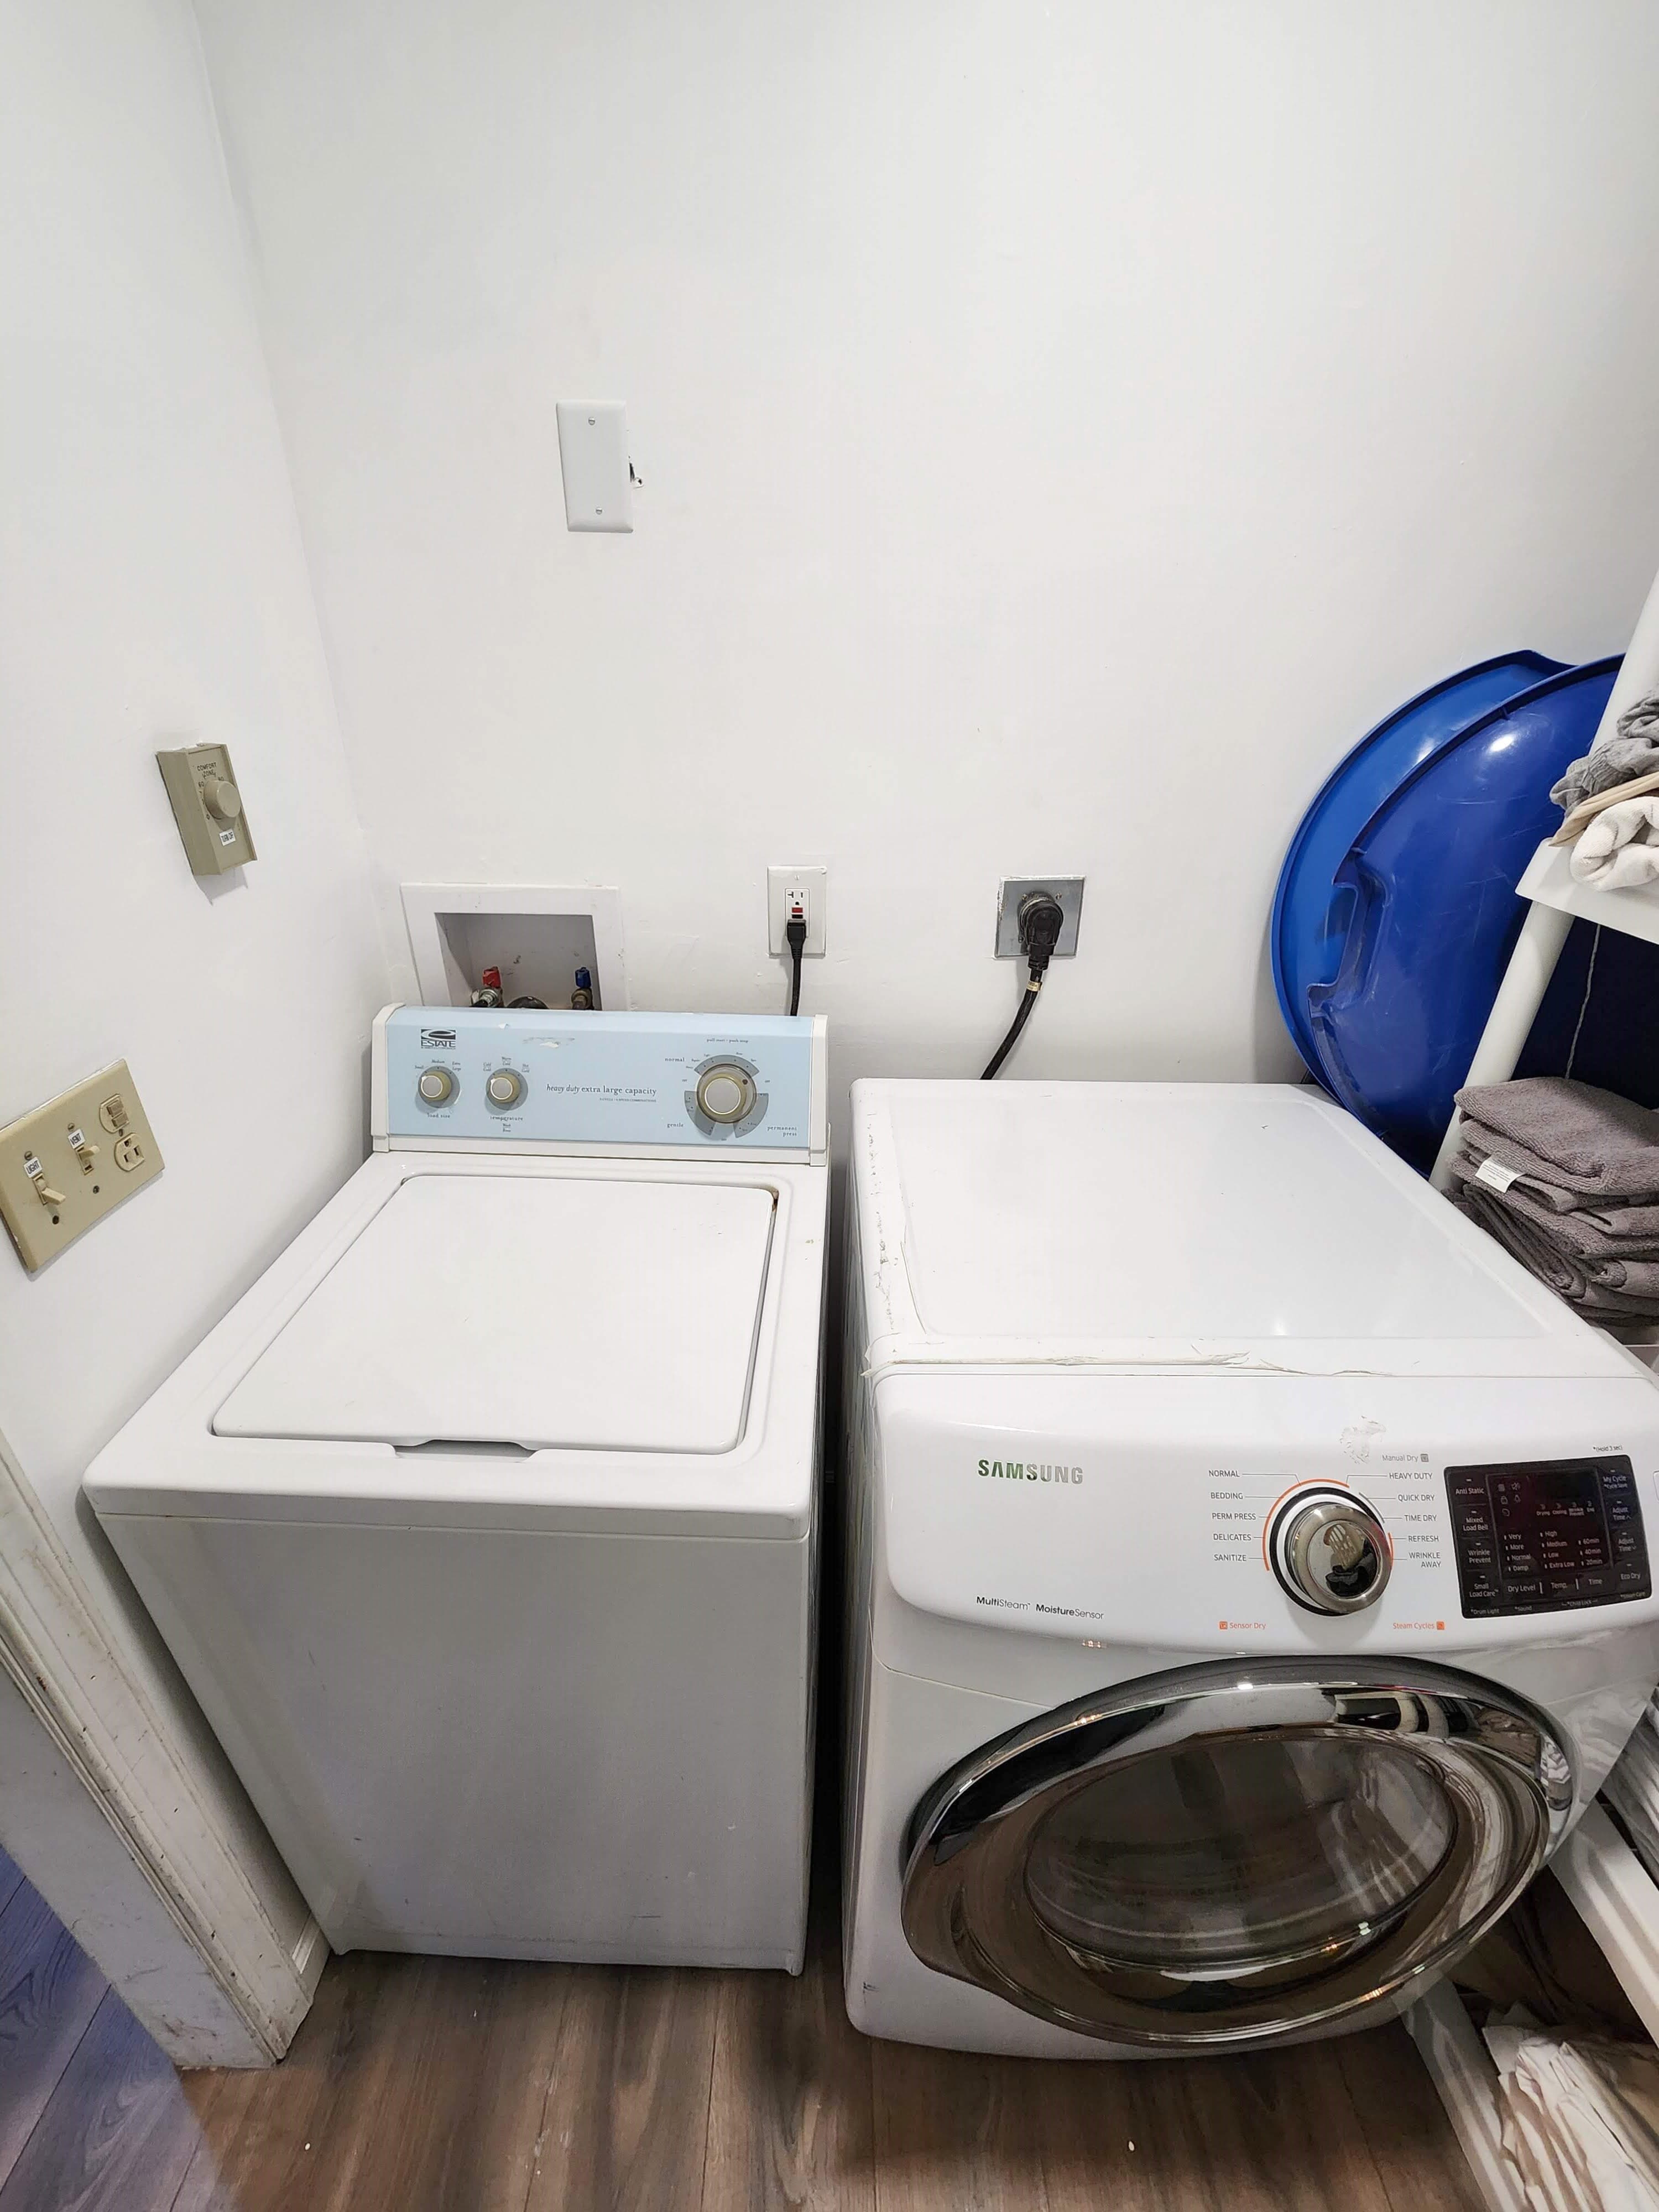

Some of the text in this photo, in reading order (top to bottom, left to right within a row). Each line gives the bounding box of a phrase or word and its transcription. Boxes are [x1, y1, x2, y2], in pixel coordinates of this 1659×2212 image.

[197, 762, 217, 771] COMFORT
[546, 1083, 565, 1094] heavy
[566, 1084, 580, 1094] duty
[603, 1086, 623, 1095] large
[625, 1087, 657, 1097] capacity
[70, 1133, 82, 1146] VENT
[25, 1160, 40, 1175] LIGHT
[1406, 1454, 1418, 1462] Dry
[978, 1459, 1083, 1484] SAMSUNG
[1035, 1604, 1104, 1620] MoistureSensor
[1229, 1621, 1266, 1630] Sensor Dry
[1415, 1622, 1434, 1631] Cycles
